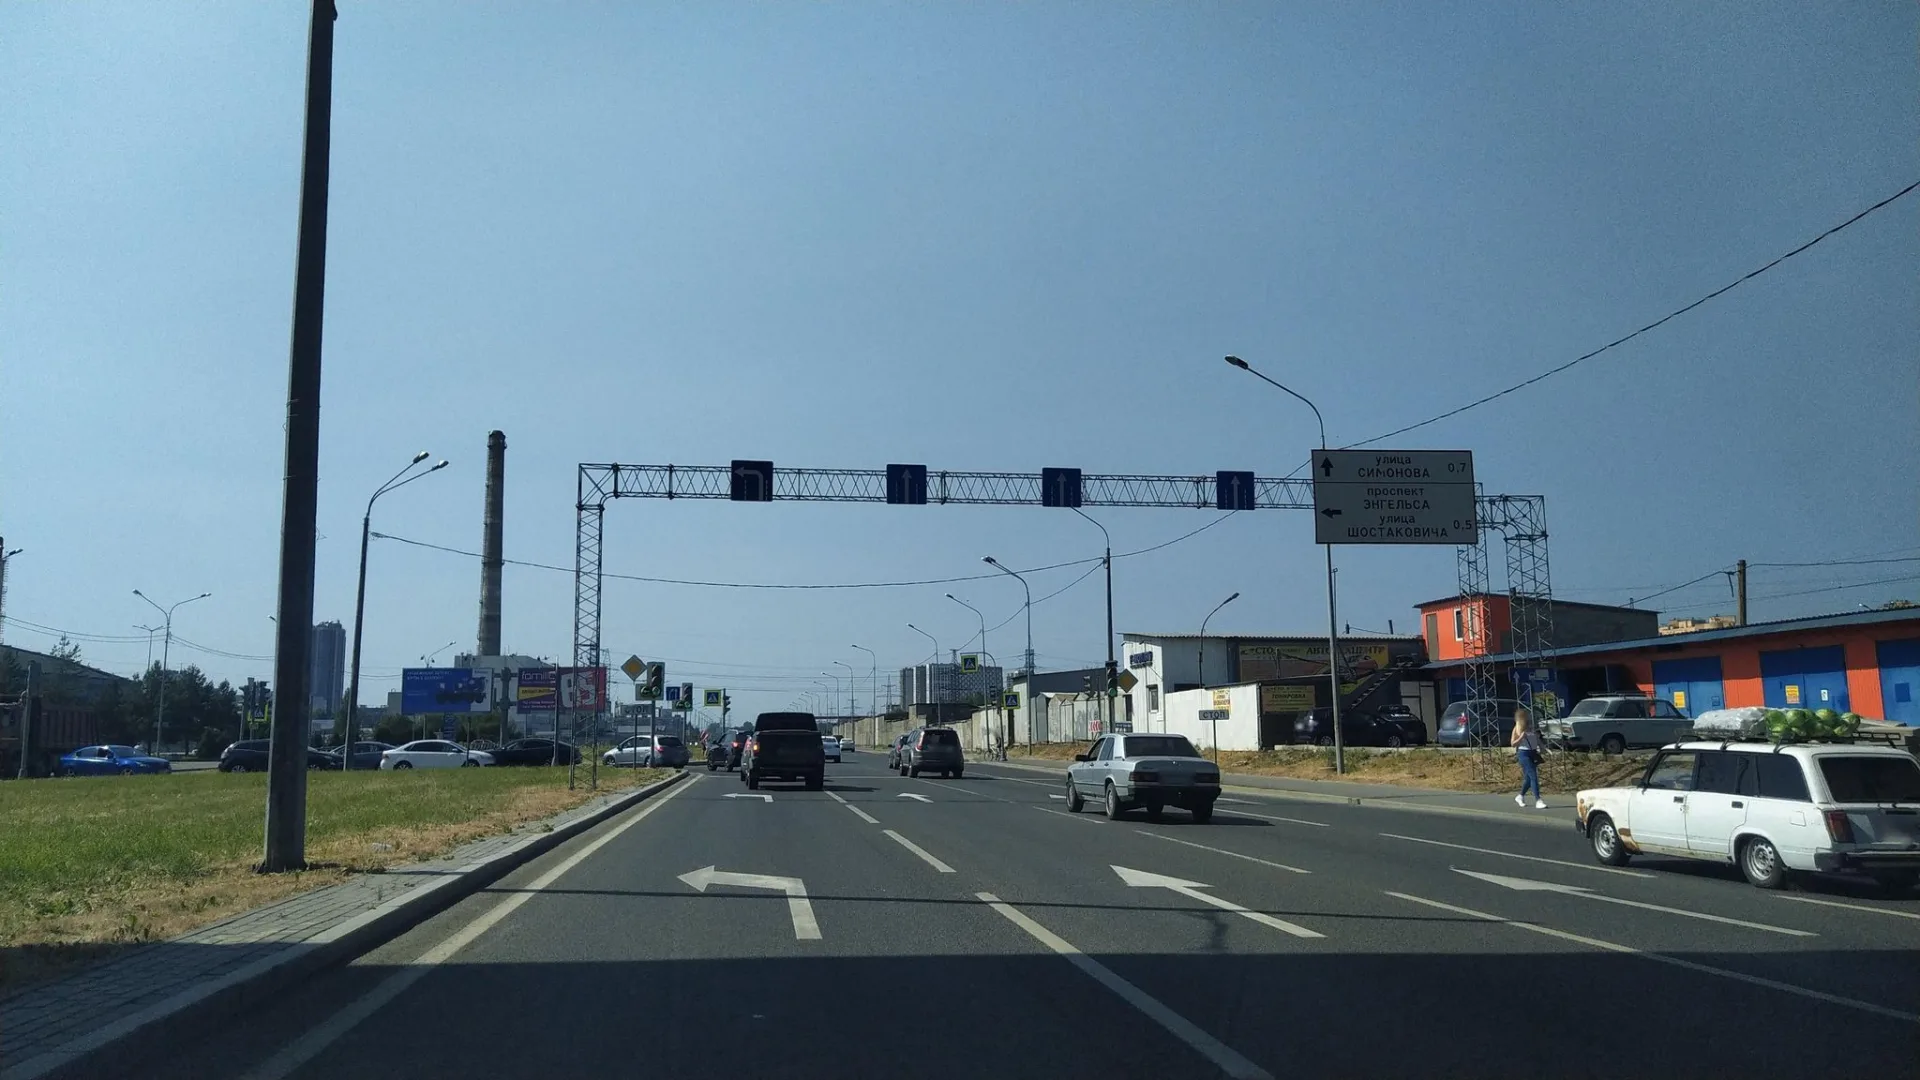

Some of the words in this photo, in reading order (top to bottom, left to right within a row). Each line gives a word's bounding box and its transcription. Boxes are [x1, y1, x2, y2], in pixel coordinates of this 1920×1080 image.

[1376, 455, 1412, 465] улица
[1358, 467, 1431, 478] СИМОНОВА
[1367, 487, 1425, 497] проспект
[1363, 499, 1431, 510] ЭНГЕЛЬСА
[1379, 514, 1416, 526] улица
[1347, 526, 1449, 538] ШОСТАКОВИЧА
[1202, 711, 1226, 719] СТОП
